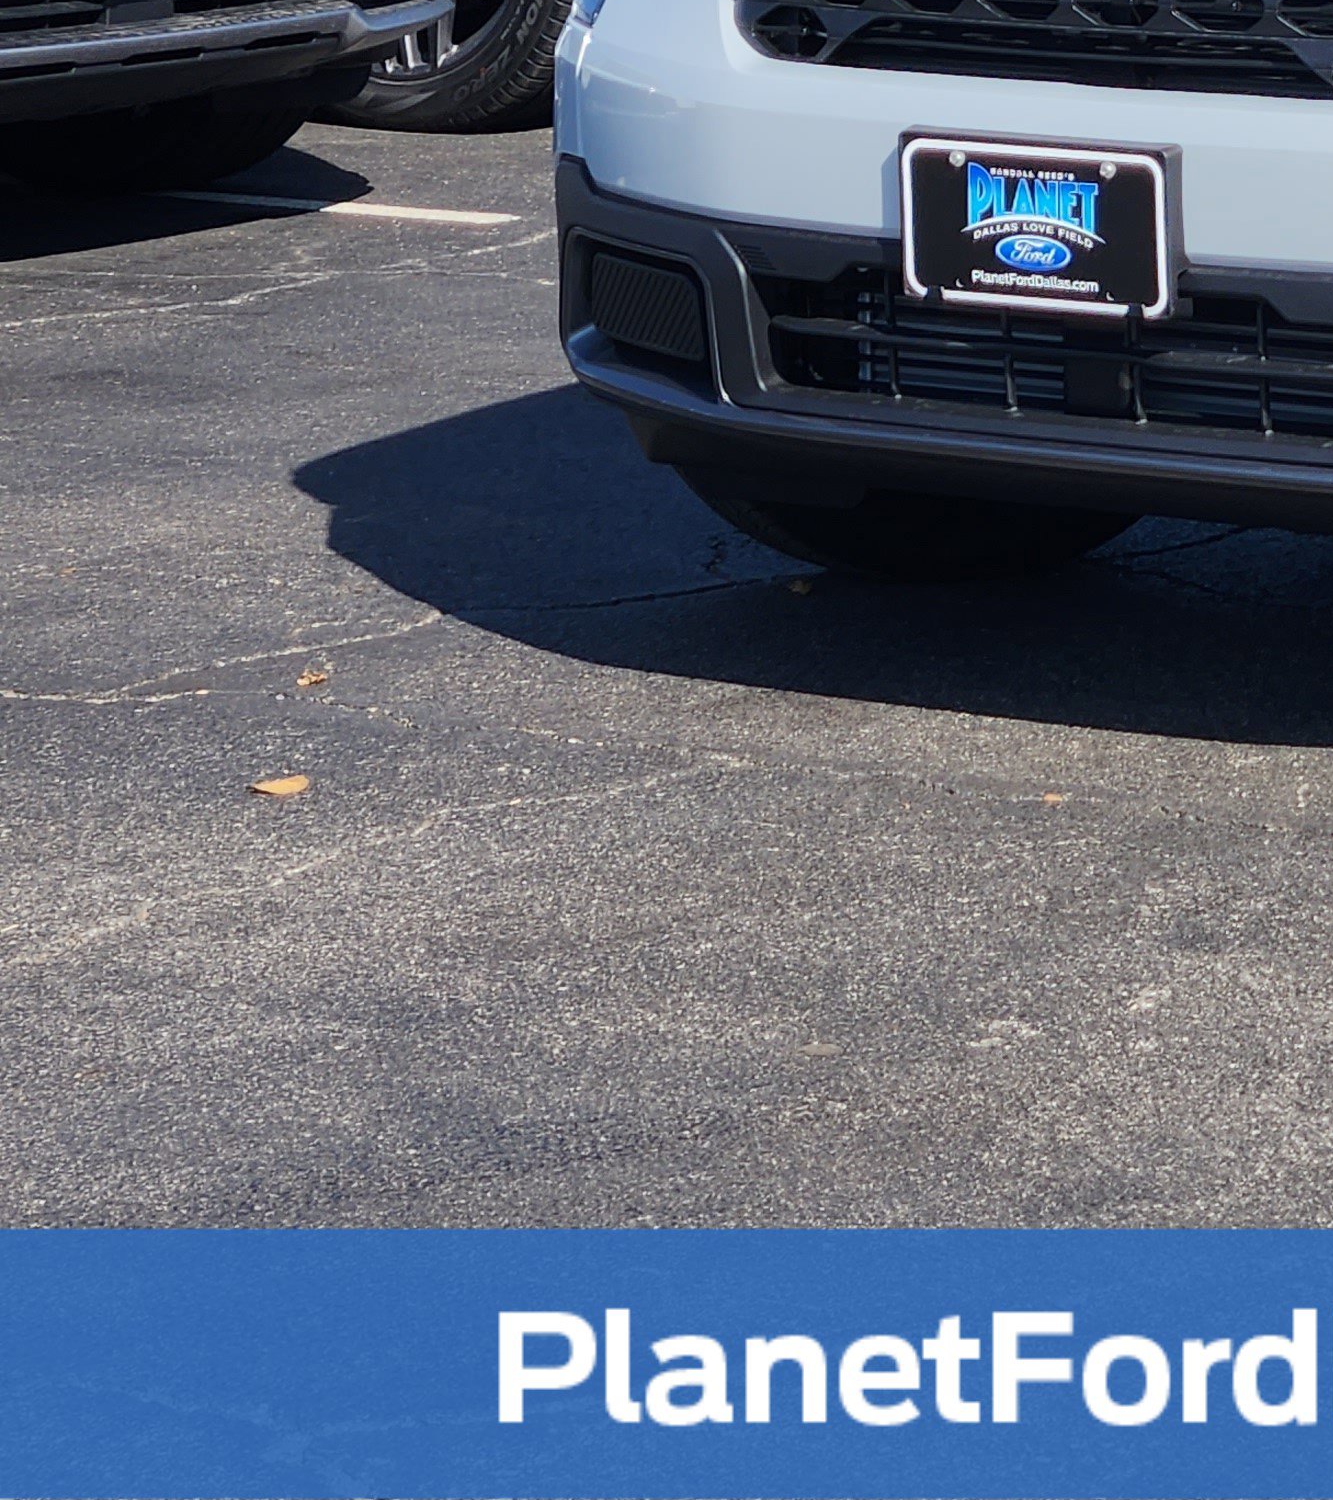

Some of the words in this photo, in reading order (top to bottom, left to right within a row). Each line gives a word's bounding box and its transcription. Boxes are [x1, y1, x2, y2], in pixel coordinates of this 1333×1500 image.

[967, 161, 1099, 234] PLANET
[973, 222, 1019, 240] DALLAS
[1023, 222, 1055, 235] LOVE
[1057, 226, 1094, 249] FIELD
[1010, 240, 1056, 266] Ford
[971, 269, 1100, 292] PlanetFordDallas.com
